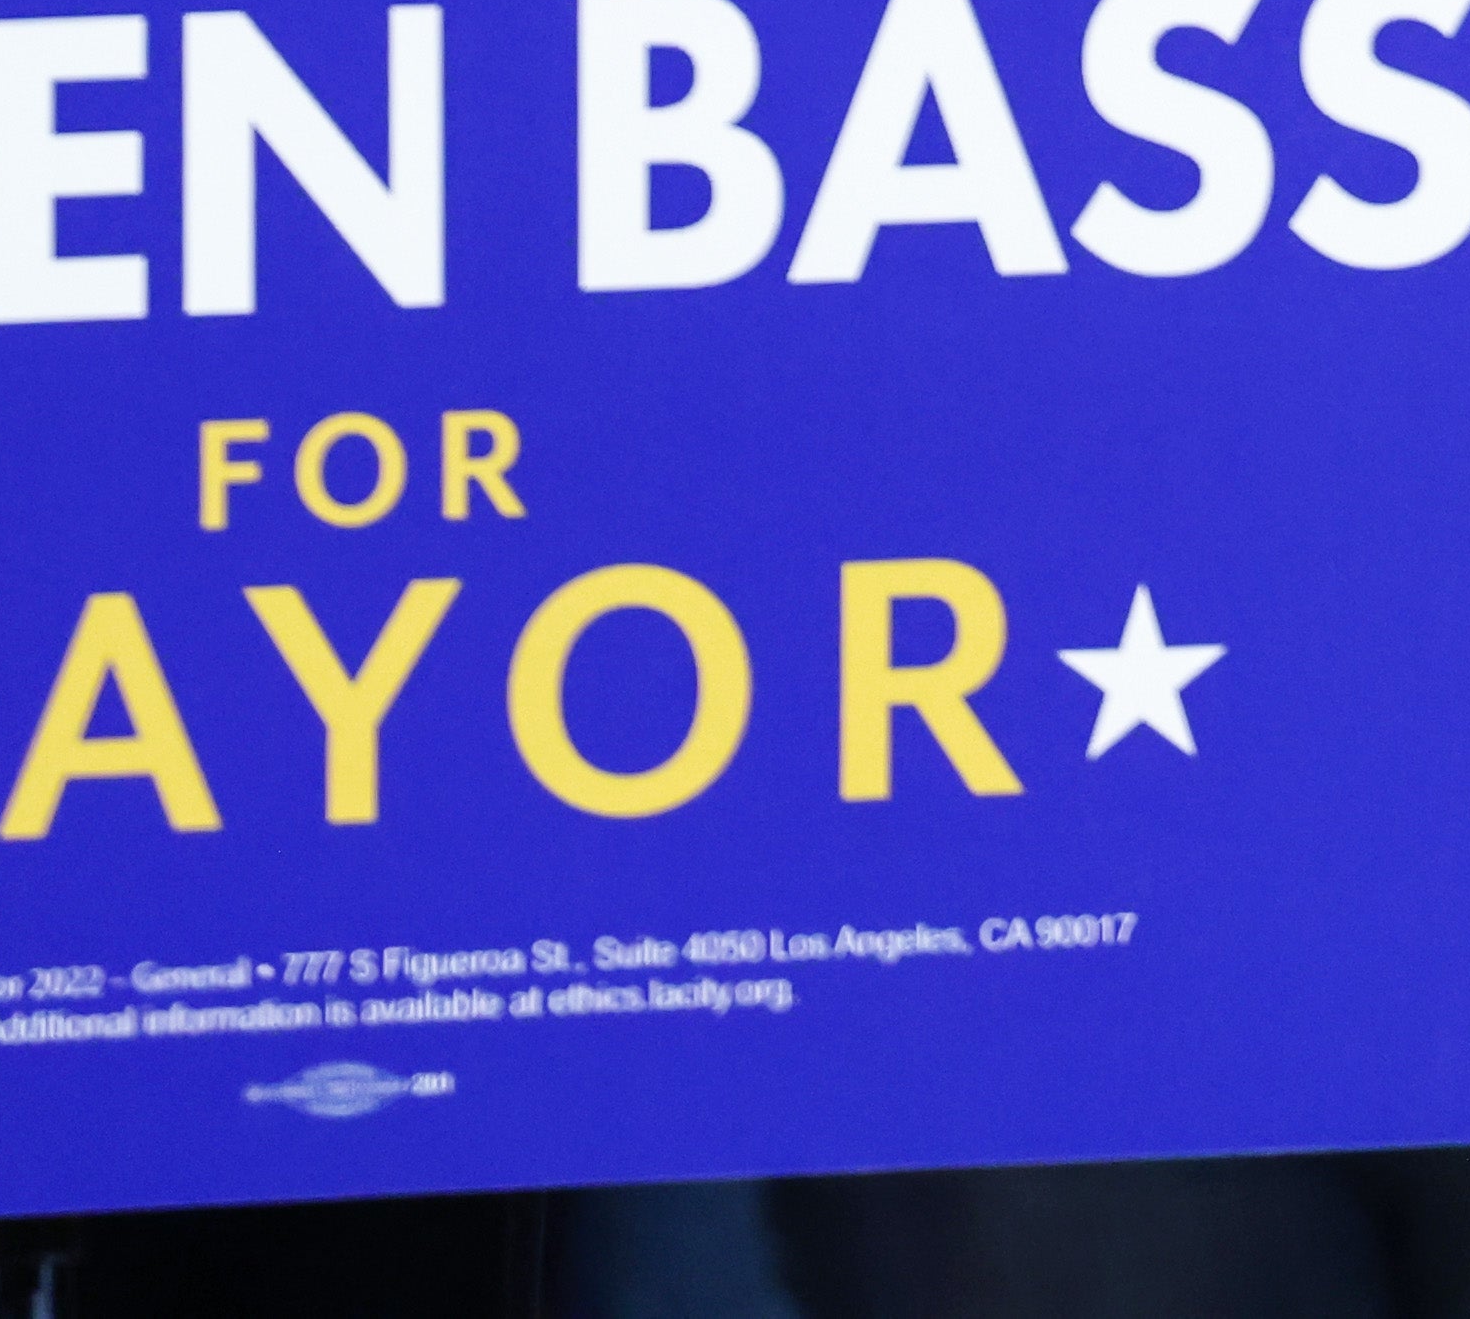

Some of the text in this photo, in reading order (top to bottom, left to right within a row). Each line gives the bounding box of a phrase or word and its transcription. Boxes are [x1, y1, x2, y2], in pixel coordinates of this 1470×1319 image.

[199, 409, 527, 531] FOR
[27, 965, 107, 1001] 2022
[129, 955, 253, 994] General
[283, 949, 345, 986] 777
[349, 948, 379, 985] S
[382, 945, 528, 989] Figueroa
[593, 935, 680, 971] Suite
[681, 928, 767, 966] 4050
[770, 925, 832, 963] Los
[832, 921, 974, 965] Angeles,
[978, 916, 1034, 953] CA
[1035, 911, 1139, 950] 90017
[141, 998, 323, 1037] information
[325, 998, 358, 1028] is
[359, 986, 506, 1026] available
[508, 985, 545, 1019] at
